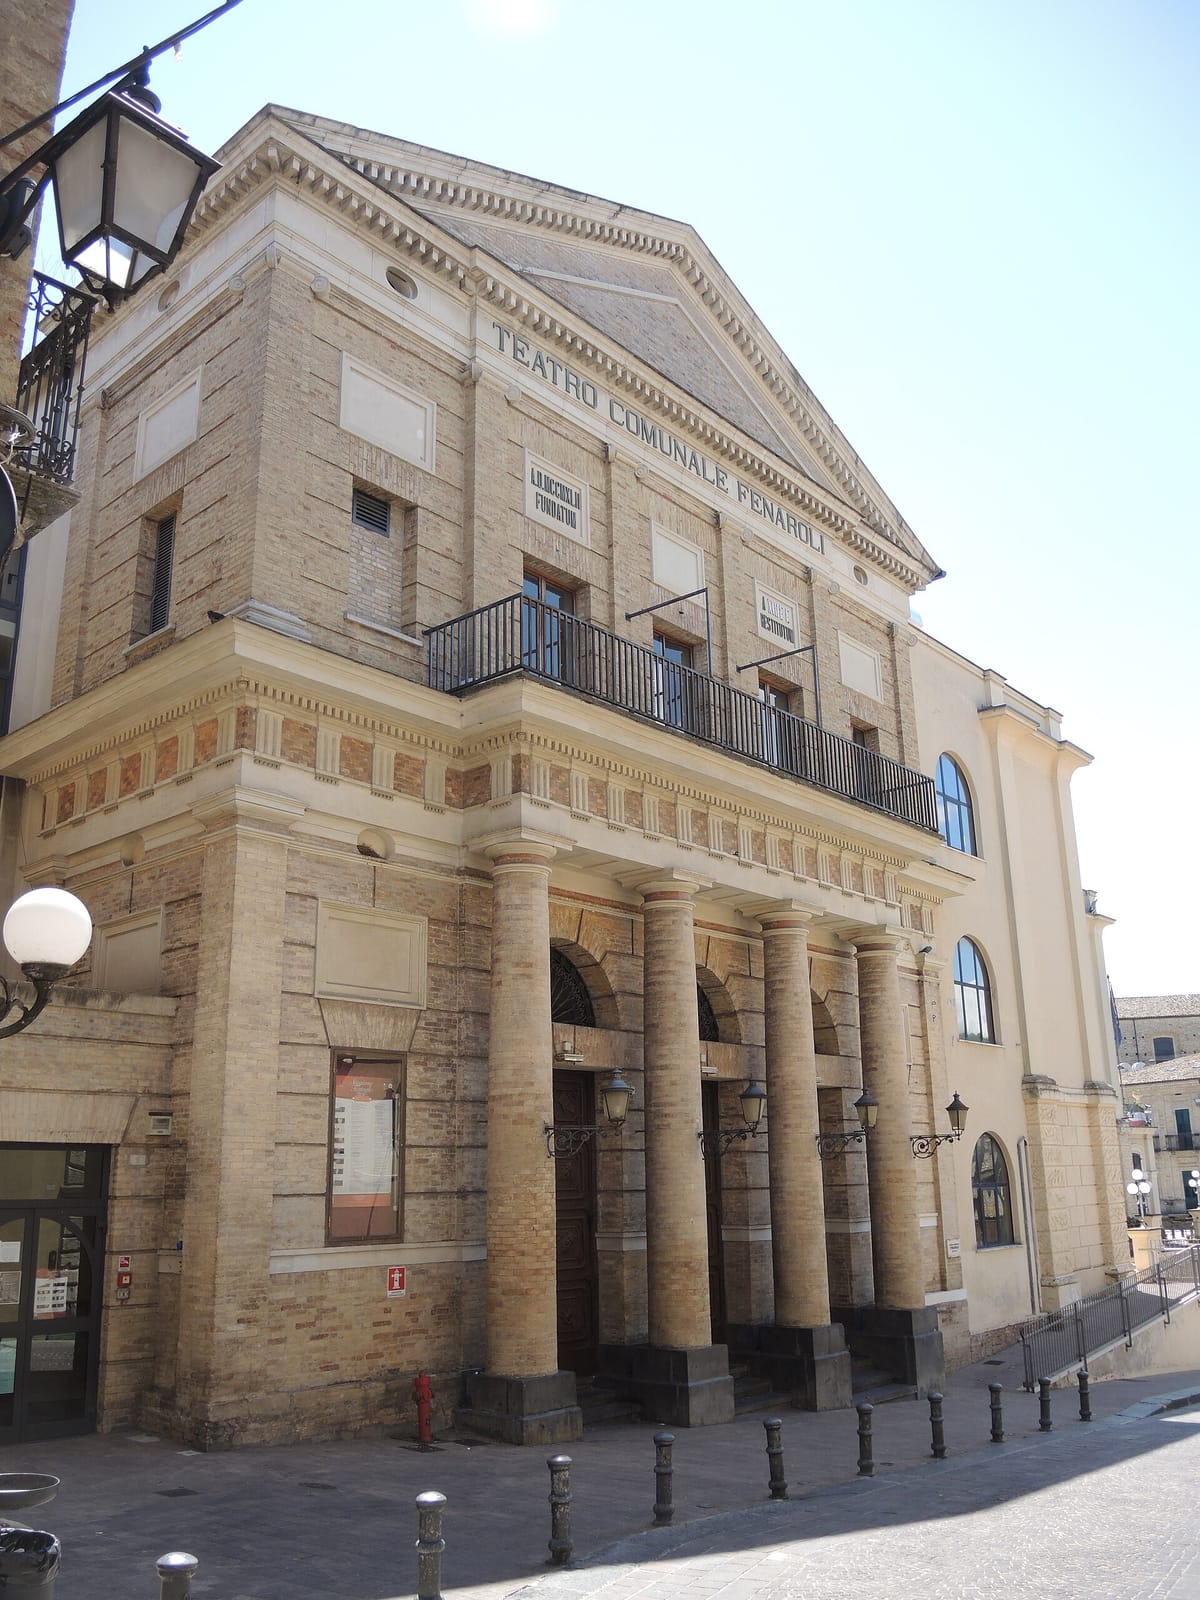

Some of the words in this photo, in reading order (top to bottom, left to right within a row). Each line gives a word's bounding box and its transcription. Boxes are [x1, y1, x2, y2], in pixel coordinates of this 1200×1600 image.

[492, 321, 598, 409] TEATRO
[609, 398, 729, 495] COMUNALE
[737, 480, 825, 555] FENAROLI
[535, 491, 577, 530] FUNDATUM
